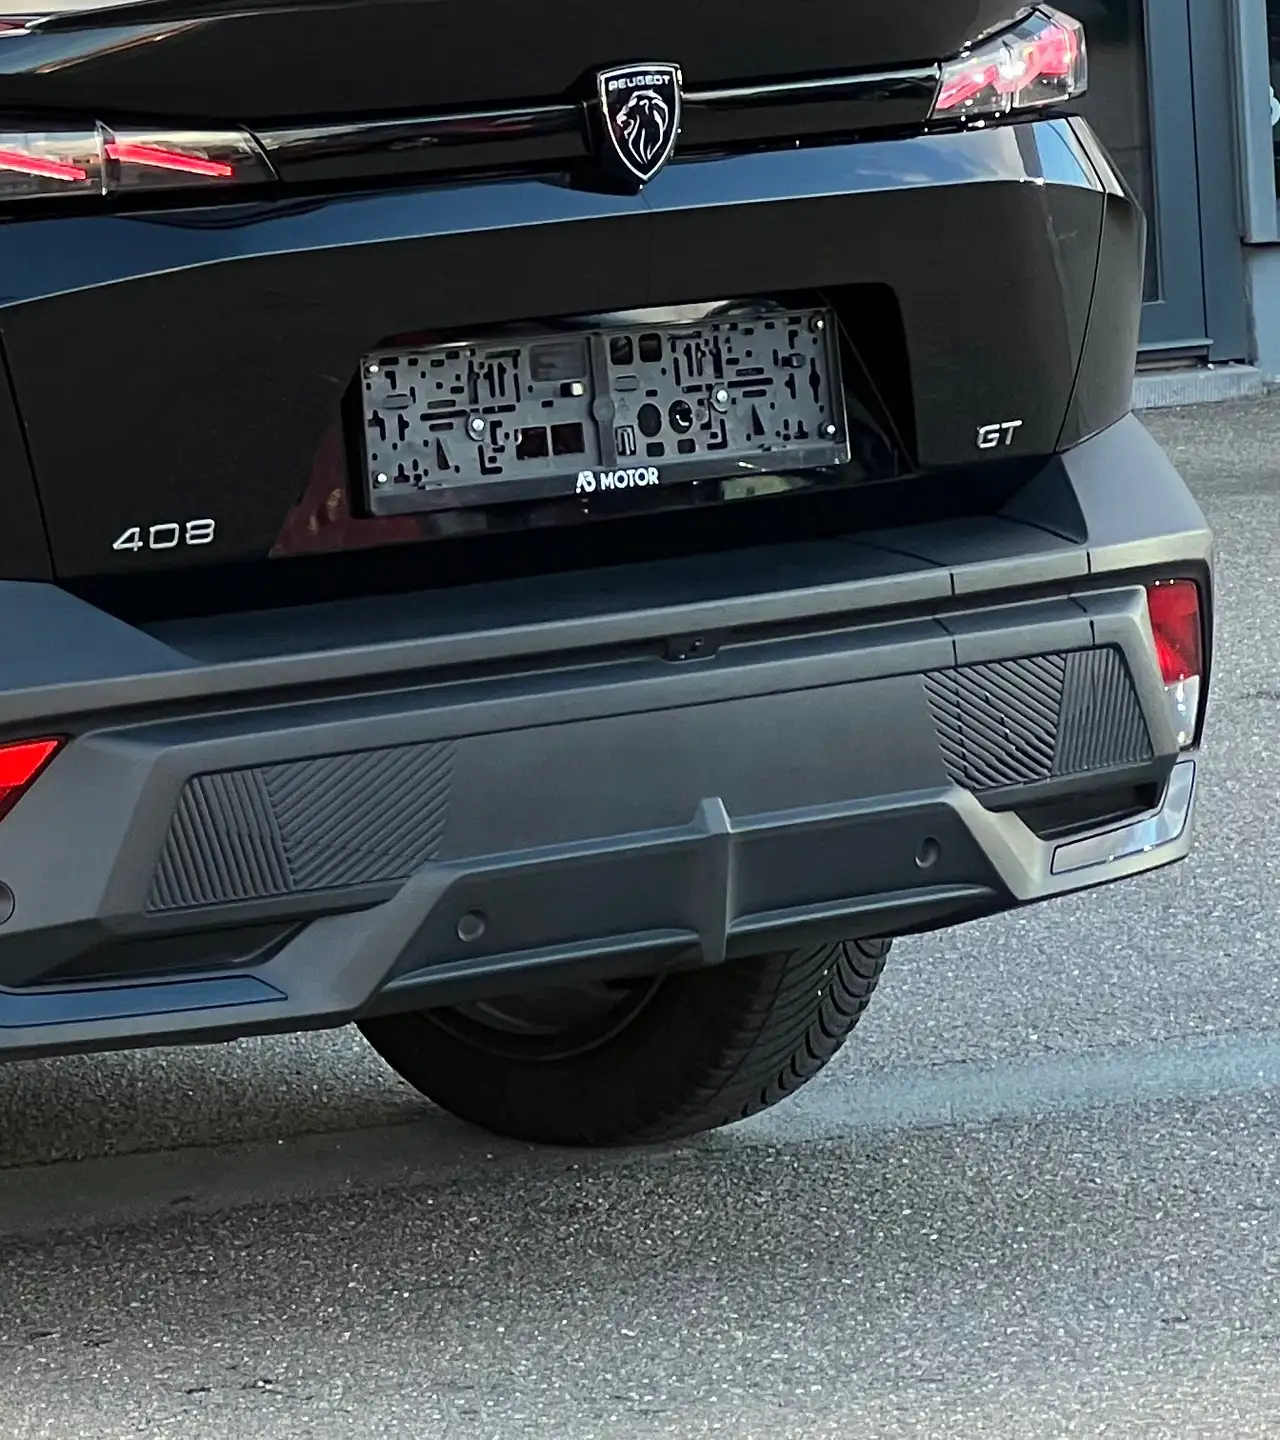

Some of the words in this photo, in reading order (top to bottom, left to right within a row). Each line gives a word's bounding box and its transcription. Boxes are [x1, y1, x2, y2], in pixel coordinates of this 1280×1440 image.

[608, 75, 670, 91] PEUGEOT
[977, 420, 1023, 449] GT
[600, 466, 659, 491] MOTOR
[112, 518, 215, 552] 408
